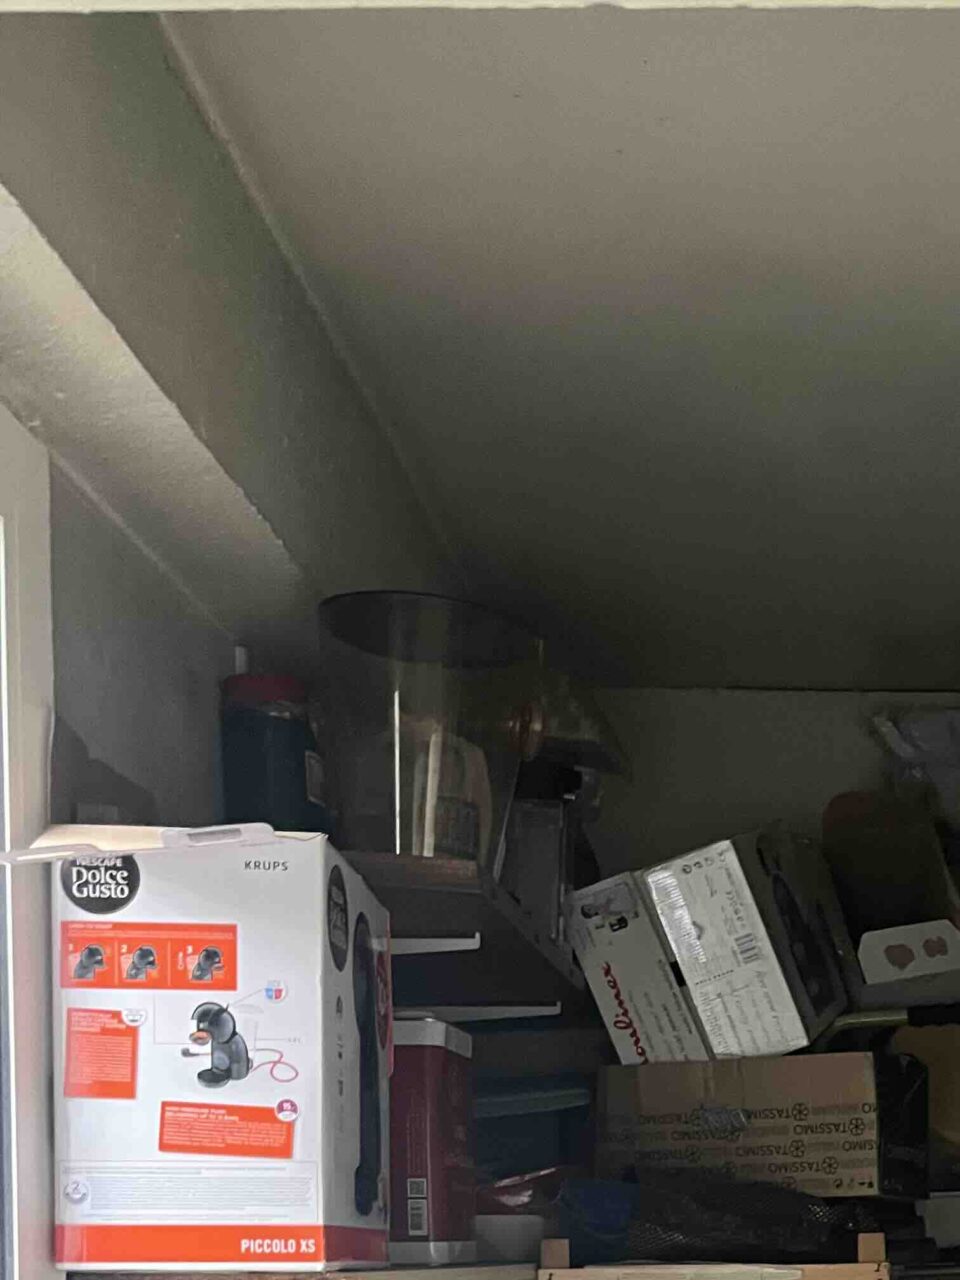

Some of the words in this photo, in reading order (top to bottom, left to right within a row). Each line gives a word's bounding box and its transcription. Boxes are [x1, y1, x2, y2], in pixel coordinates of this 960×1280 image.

[243, 859, 290, 873] KRUPS
[72, 866, 129, 885] Dolce
[72, 883, 130, 899] Gusto
[792, 1123, 850, 1137] TASSIMO
[734, 1143, 789, 1159] TASSIMO
[767, 1160, 822, 1175] TASSIMO
[240, 1238, 296, 1254] PICCOLO
[300, 1239, 316, 1253] XS
